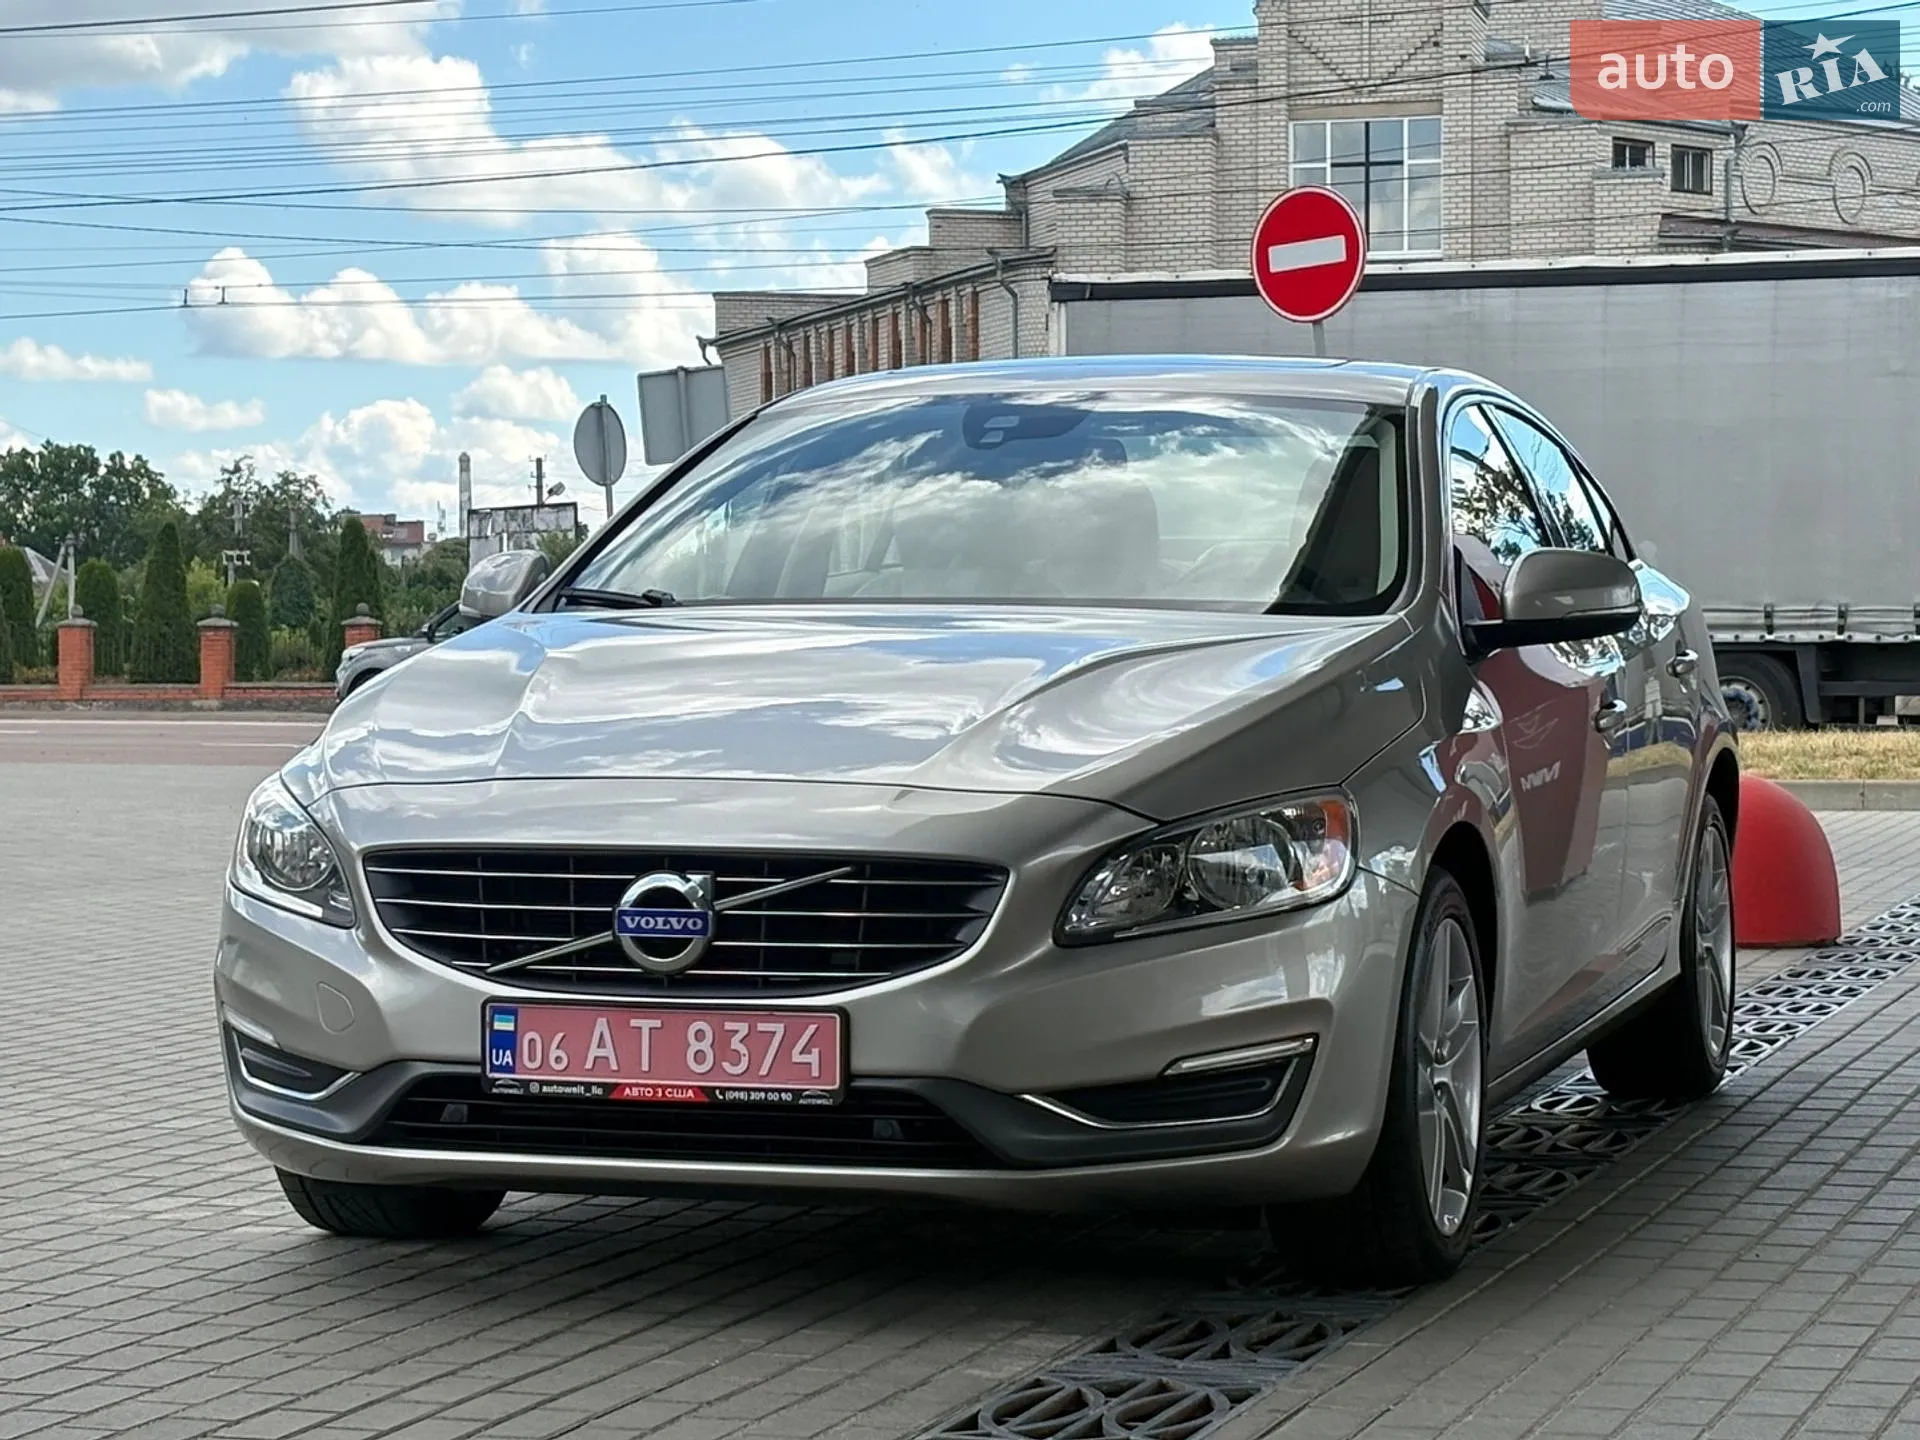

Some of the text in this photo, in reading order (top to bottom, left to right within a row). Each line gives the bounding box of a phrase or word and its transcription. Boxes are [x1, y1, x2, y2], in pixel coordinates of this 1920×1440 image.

[622, 915, 703, 930] VOLVO
[492, 1017, 820, 1078] UA 06 AT 8374
[623, 1086, 654, 1098] АВТО
[665, 1088, 695, 1100] США
[750, 1091, 766, 1101] 309
[766, 1091, 780, 1101] 00
[780, 1092, 793, 1102] 90
